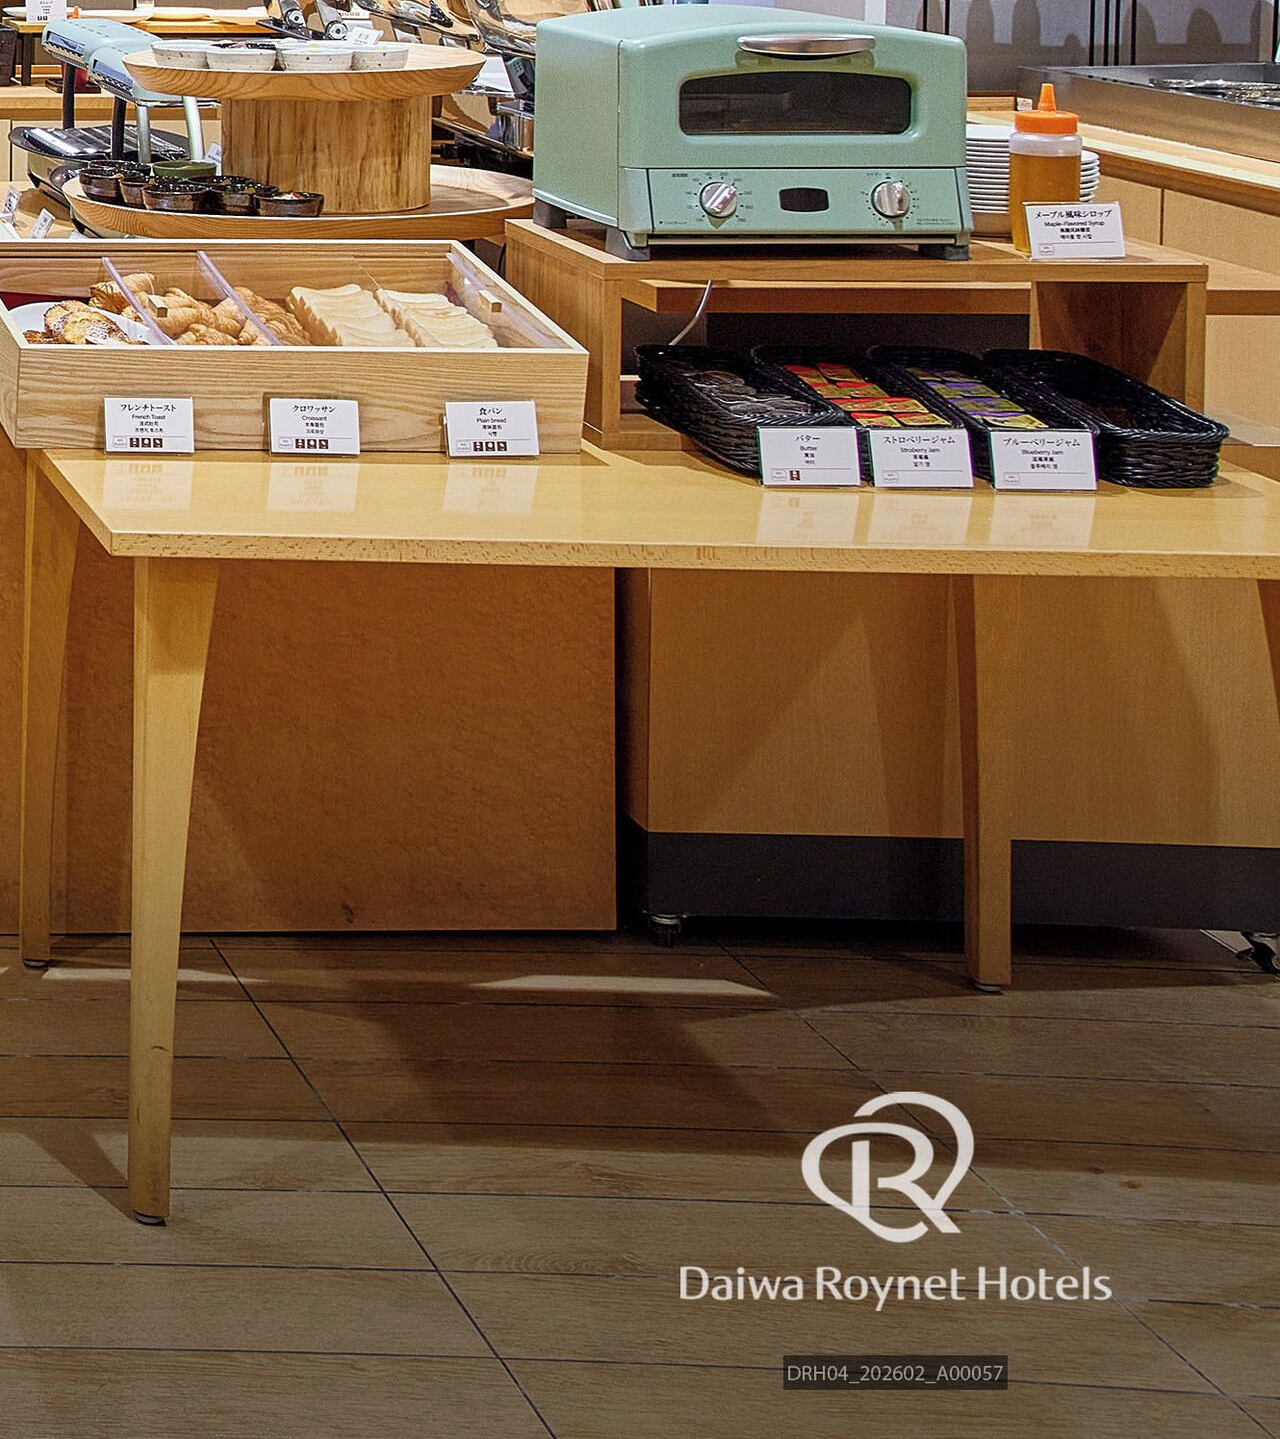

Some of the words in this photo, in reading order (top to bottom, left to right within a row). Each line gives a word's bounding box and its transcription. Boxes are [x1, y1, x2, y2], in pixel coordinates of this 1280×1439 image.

[1035, 209, 1112, 219] メープル風味シロップ
[120, 404, 177, 412] フレンチトースト
[292, 405, 336, 413] クロワッサン
[480, 407, 503, 415] 食パン
[883, 436, 955, 444] ストロベリージャム
[1003, 438, 1080, 446] ブルーベリージャム
